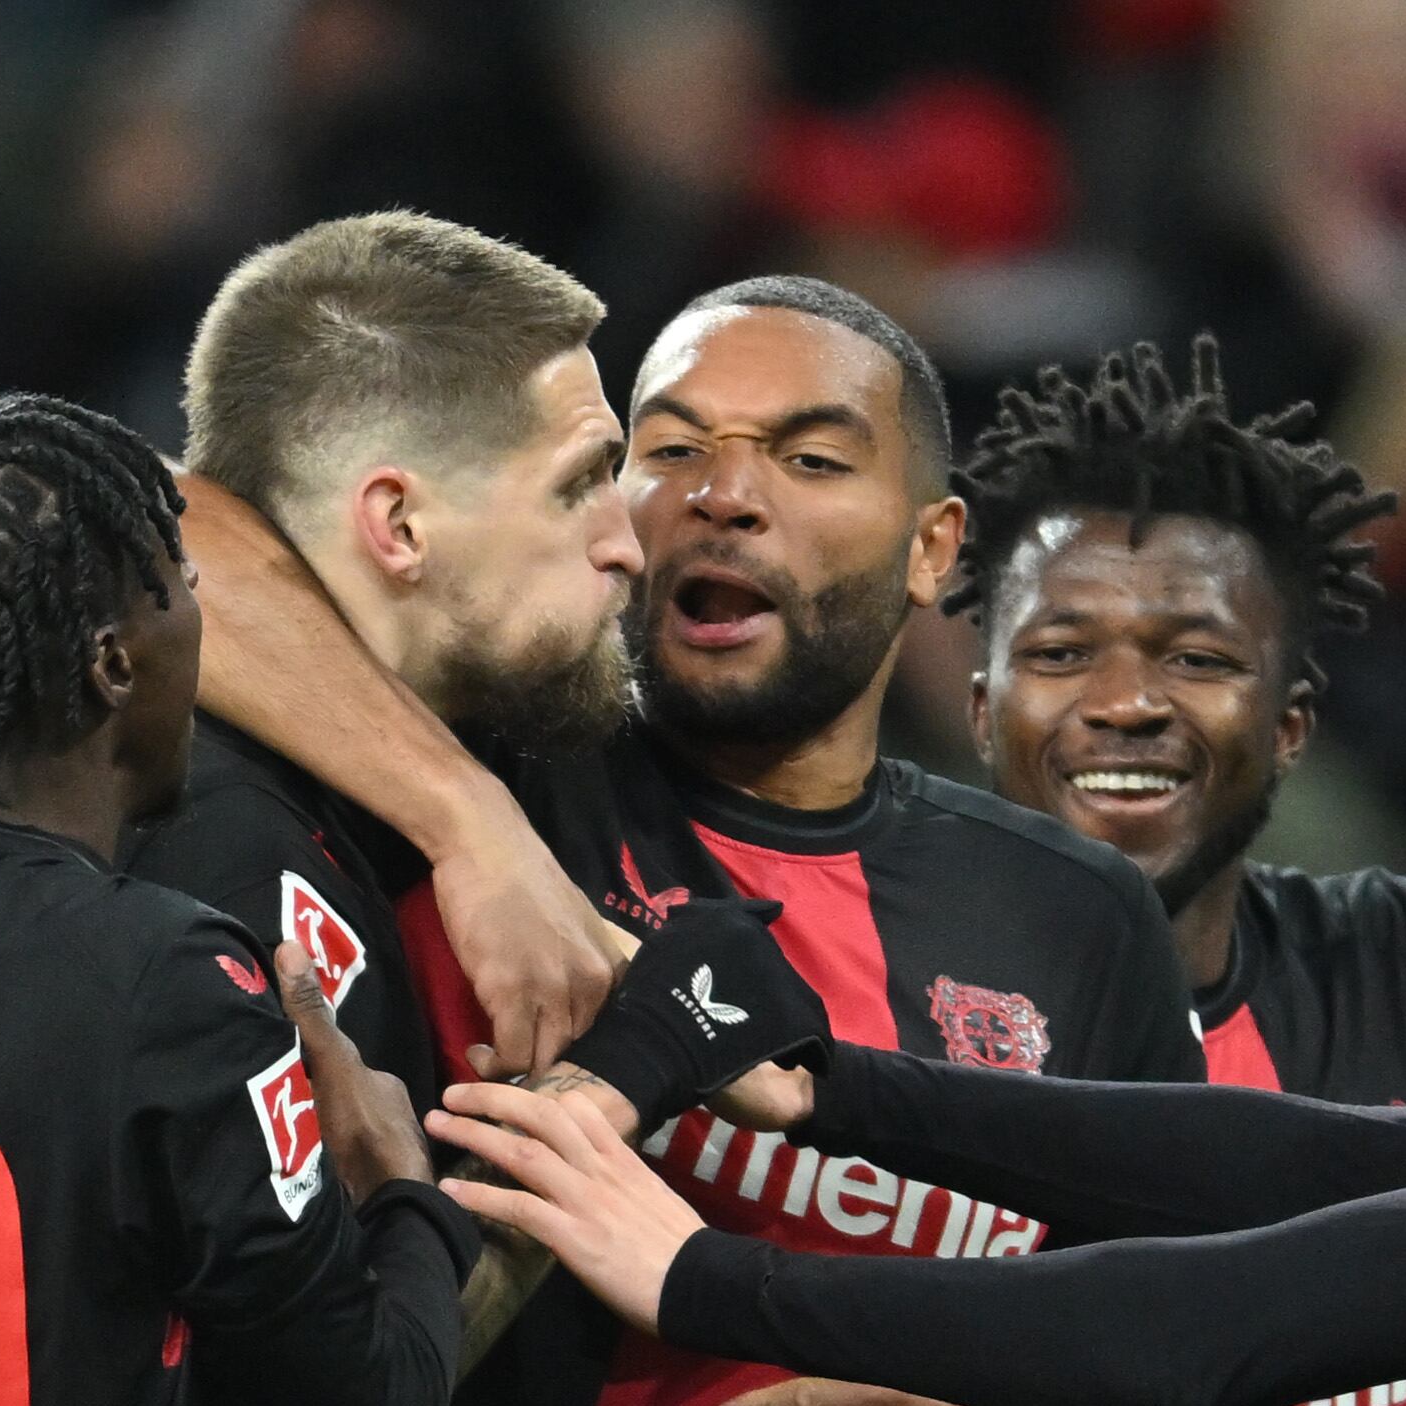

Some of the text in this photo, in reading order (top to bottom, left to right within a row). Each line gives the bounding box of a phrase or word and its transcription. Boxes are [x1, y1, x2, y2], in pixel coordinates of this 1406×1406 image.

[604, 890, 663, 930] CASTO
[670, 986, 718, 1042] CASTORE
[642, 1103, 1041, 1259] menia
